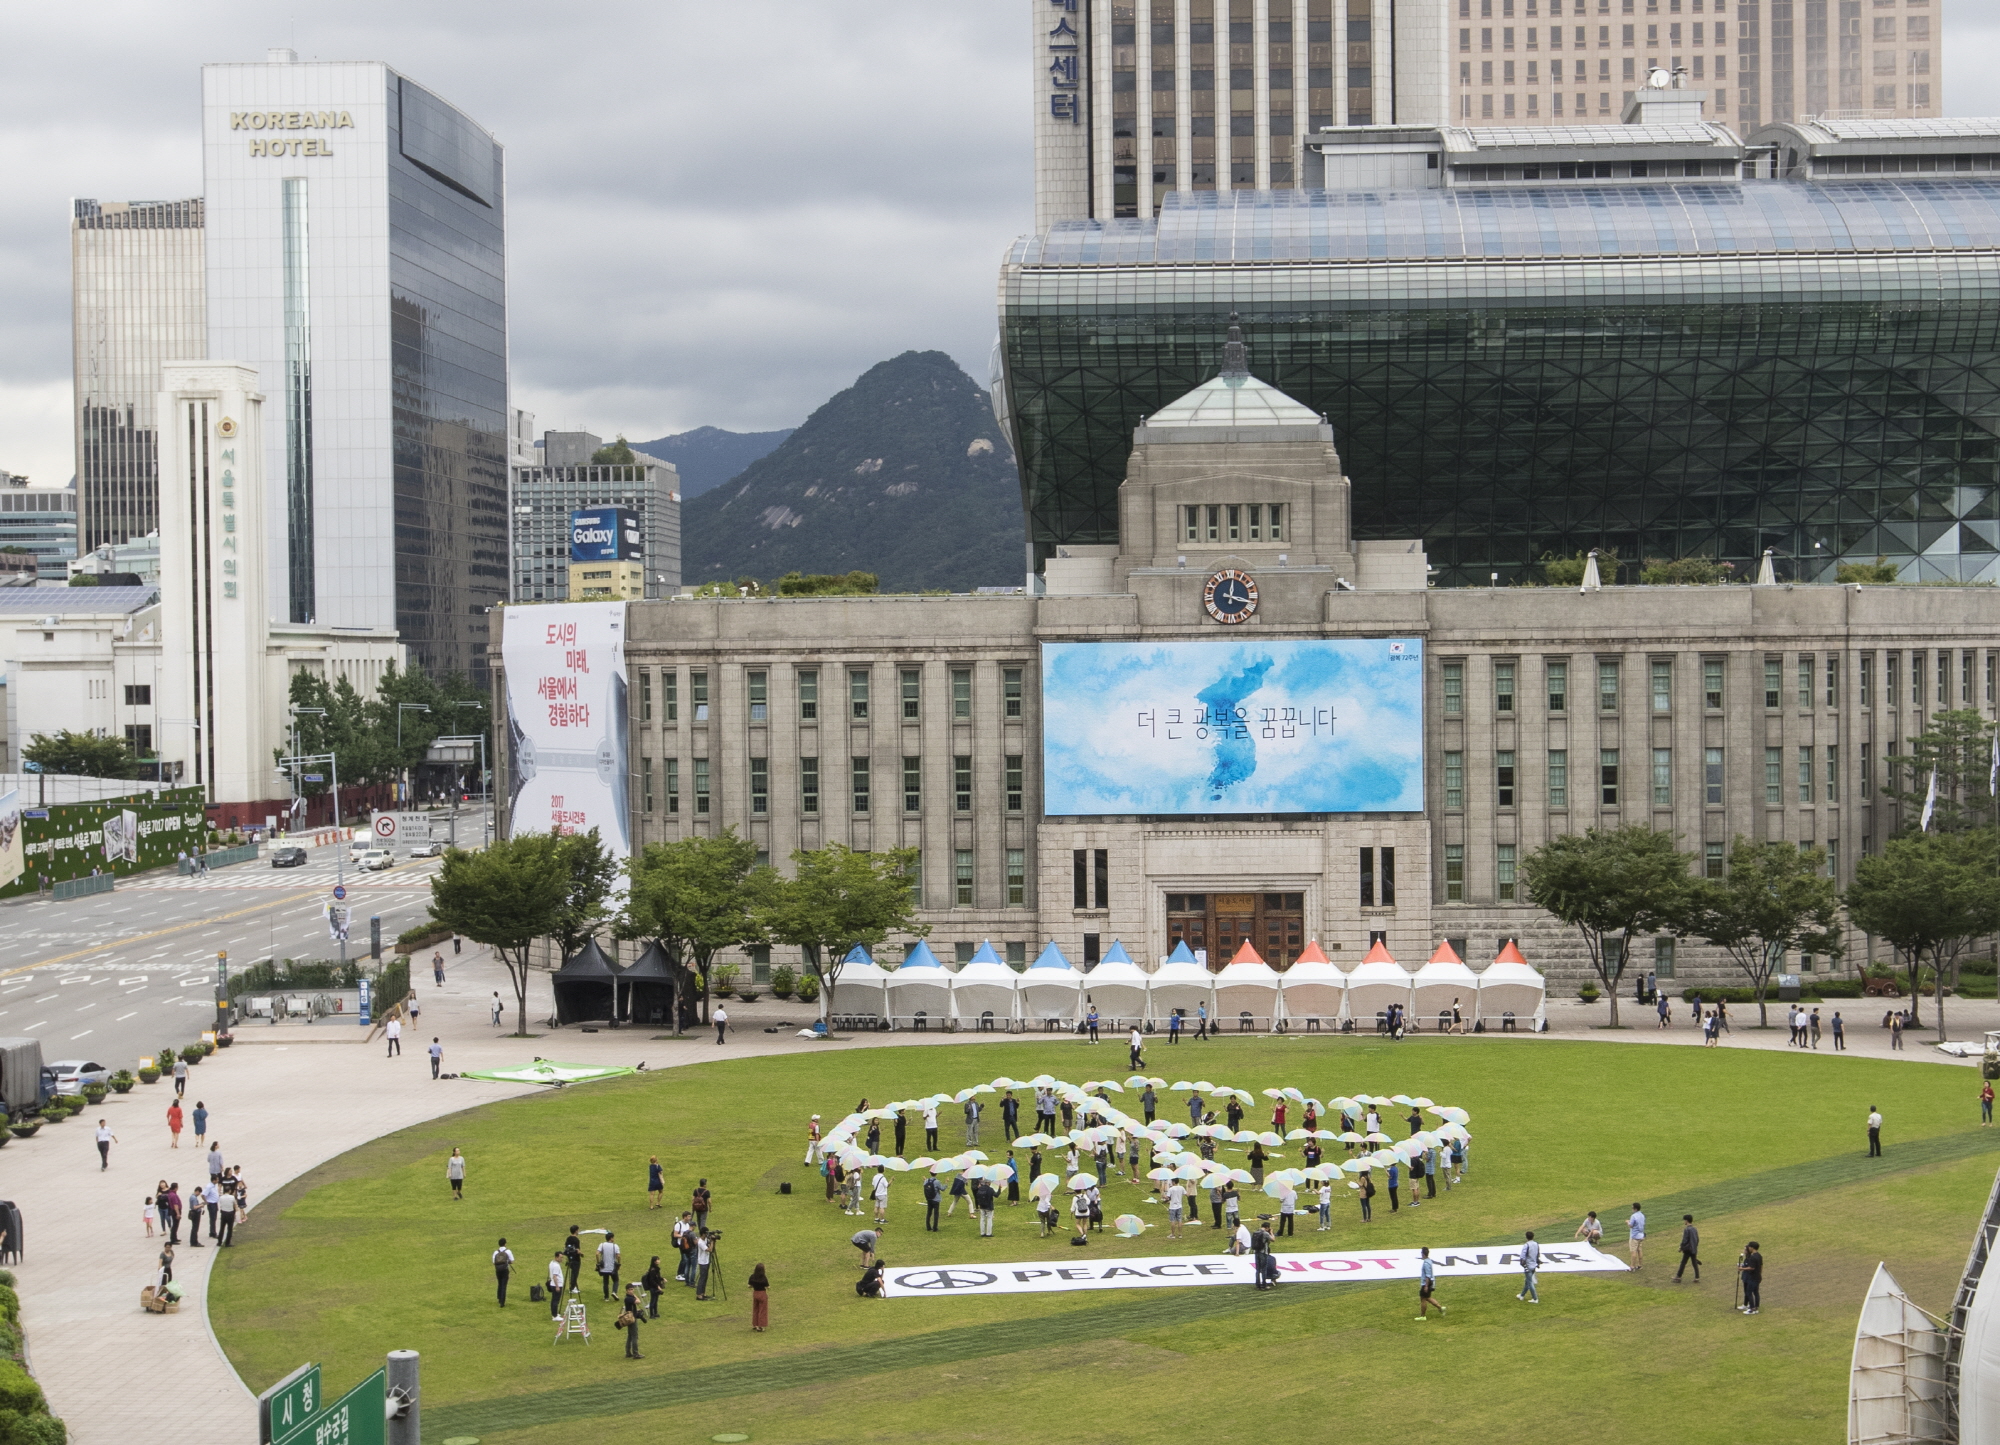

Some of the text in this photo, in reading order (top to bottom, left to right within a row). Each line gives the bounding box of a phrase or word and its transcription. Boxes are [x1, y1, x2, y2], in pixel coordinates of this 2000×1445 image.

[231, 111, 354, 130] KOREANA
[249, 139, 333, 156] HOTEL
[574, 517, 600, 526] SAMSUNG
[574, 528, 614, 546] Galaxy
[546, 622, 577, 646] 도시의
[566, 650, 589, 674] 미래,
[538, 677, 577, 700] 서울에서
[548, 703, 590, 727] 경험하다
[1138, 706, 1337, 739] 더 큰 광복을 꿈꿉니다
[551, 795, 564, 808] 2017
[138, 816, 180, 838] 서울로 7017 OPEN
[551, 810, 586, 825] 서울도시건축
[74, 832, 90, 850] 서울로
[90, 830, 102, 845] 7017
[1011, 1263, 1234, 1283] PEACE
[1418, 1252, 1596, 1266] WAR
[282, 1378, 312, 1425] 시청
